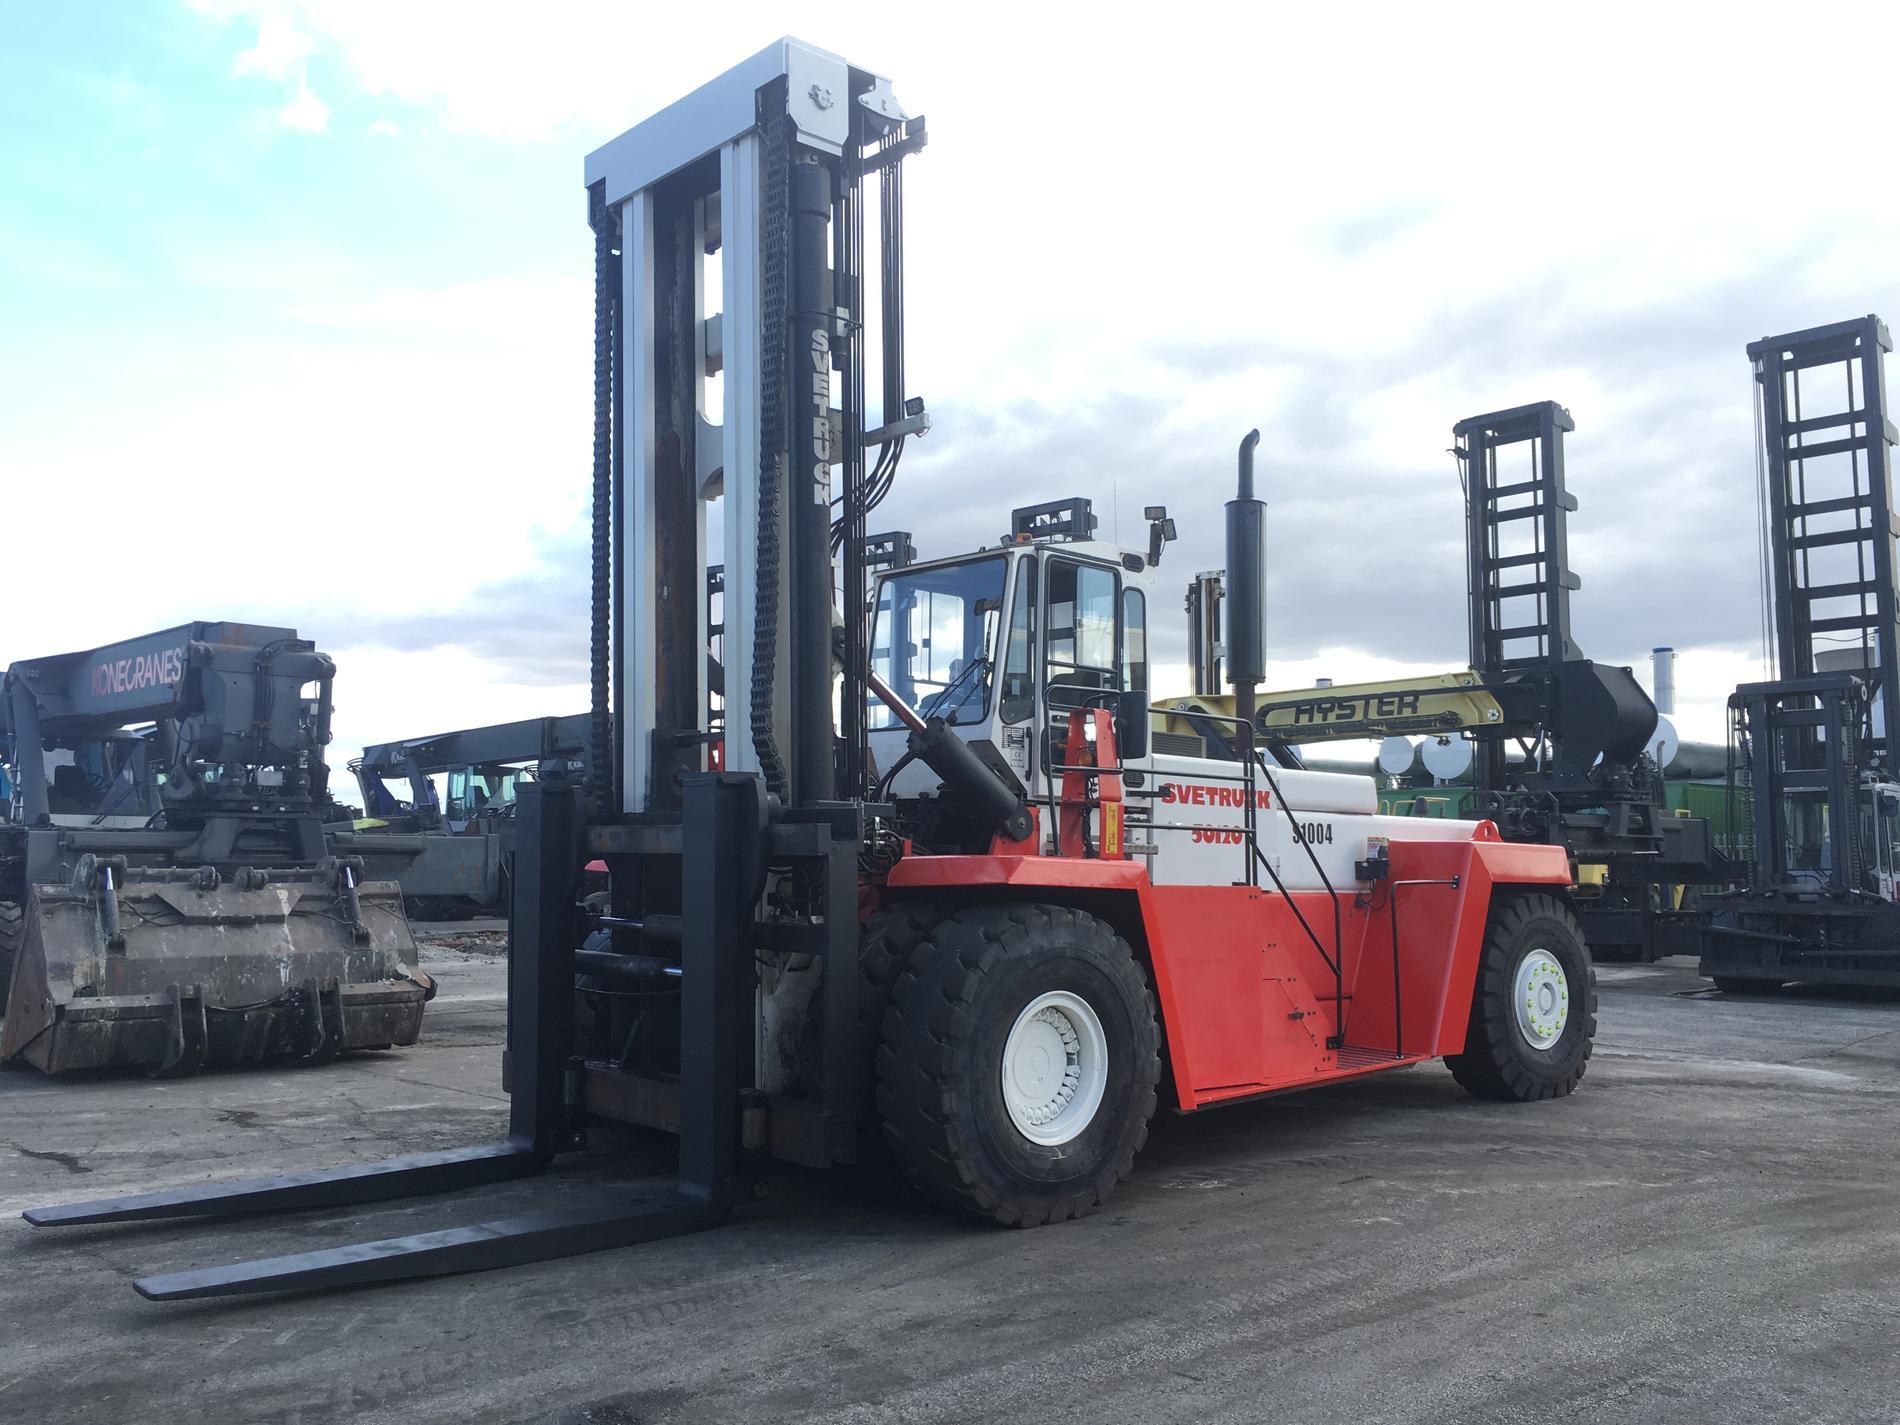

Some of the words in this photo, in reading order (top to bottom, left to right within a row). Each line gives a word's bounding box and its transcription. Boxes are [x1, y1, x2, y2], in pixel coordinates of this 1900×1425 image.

[811, 328, 830, 506] SVETRUCK
[91, 647, 182, 697] KONECRANES
[1293, 694, 1419, 724] HYSTER
[1191, 823, 1243, 845] 50120
